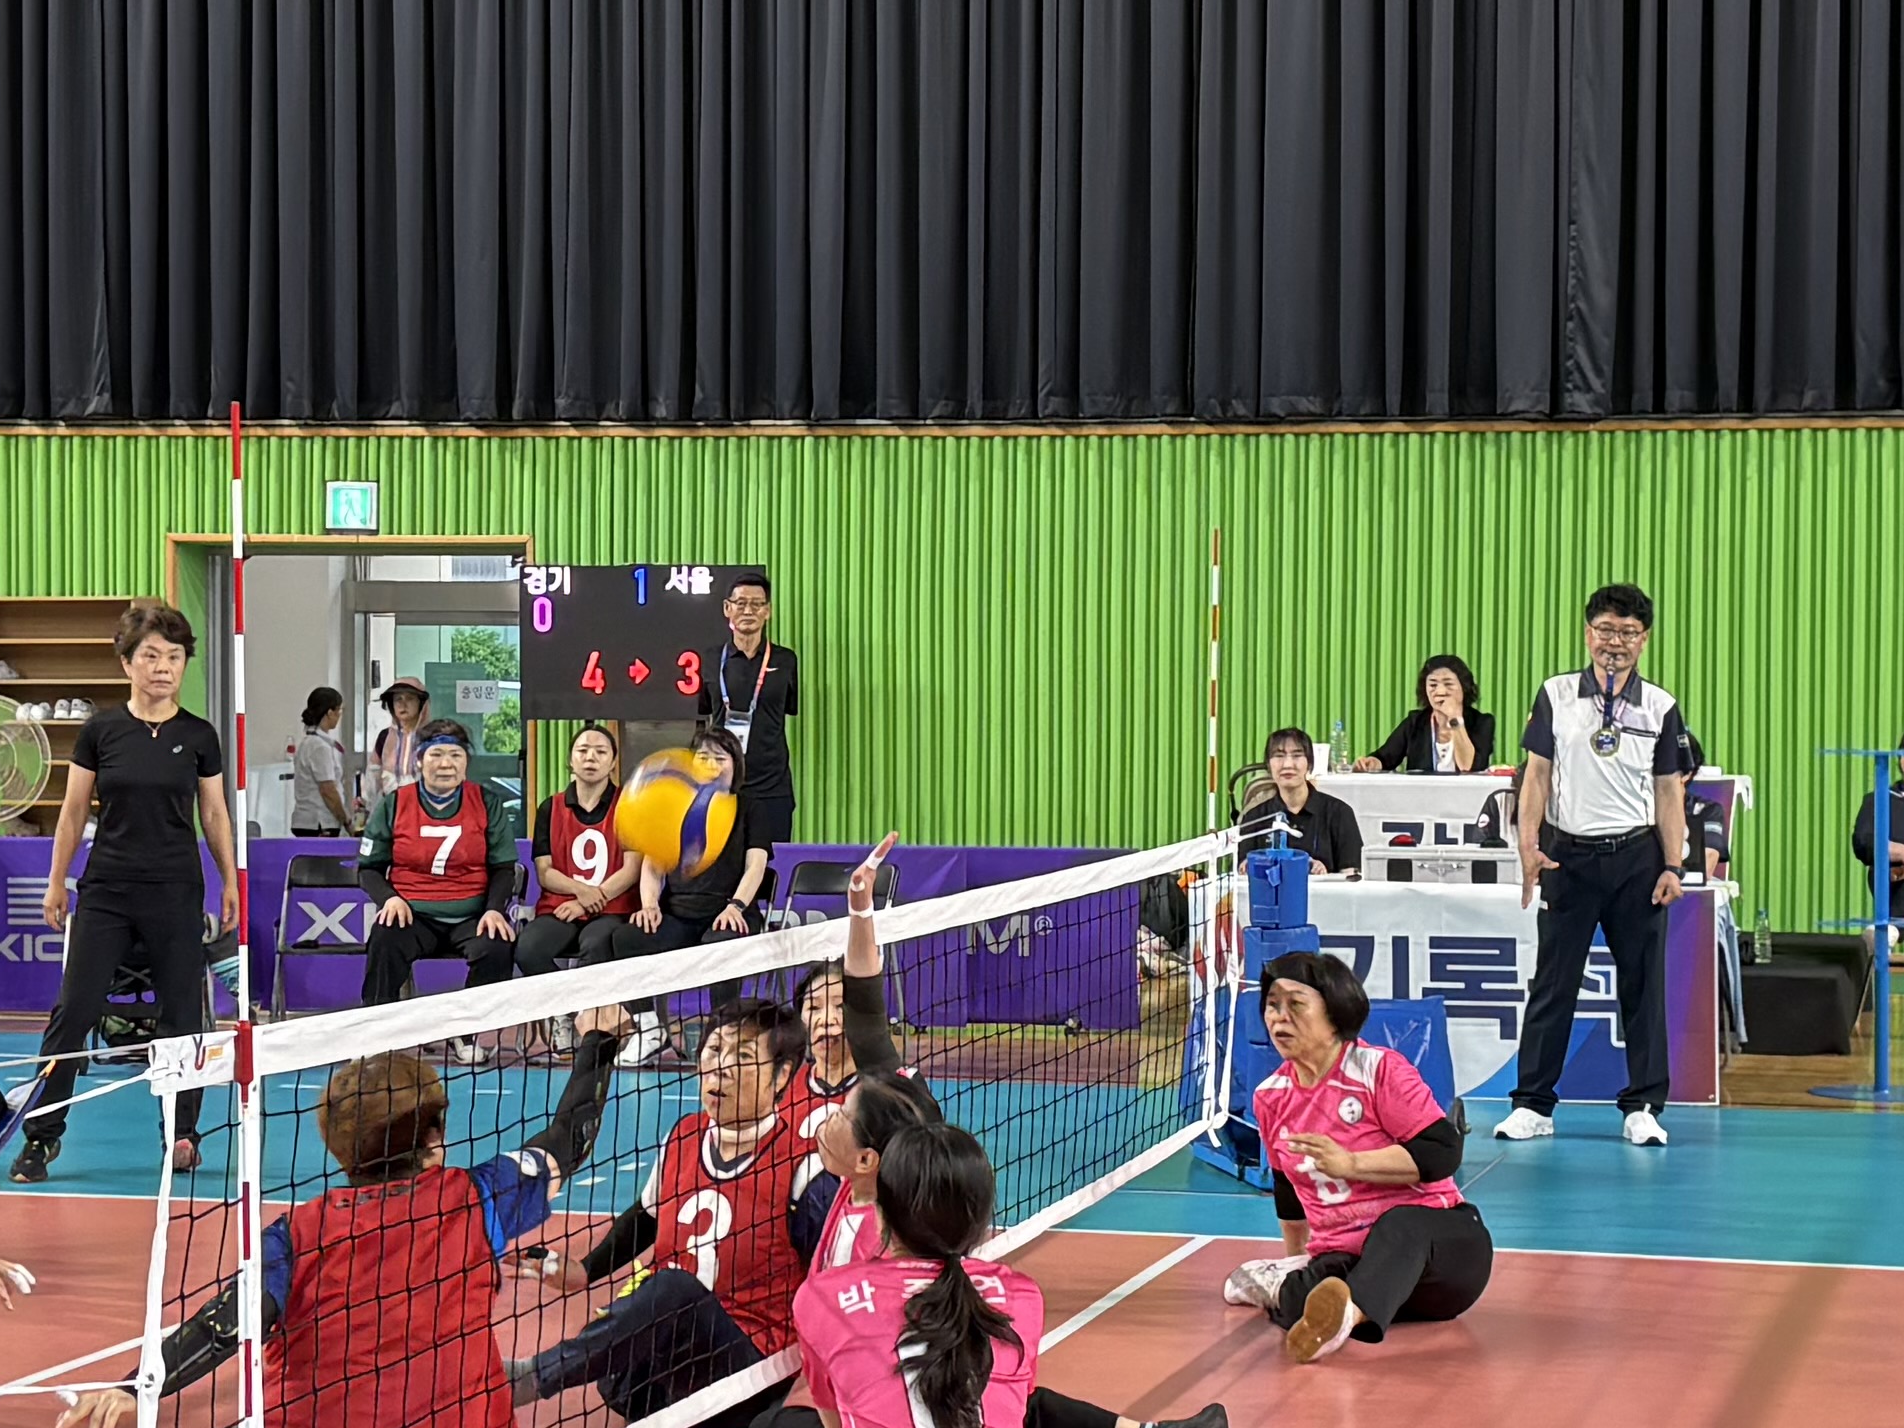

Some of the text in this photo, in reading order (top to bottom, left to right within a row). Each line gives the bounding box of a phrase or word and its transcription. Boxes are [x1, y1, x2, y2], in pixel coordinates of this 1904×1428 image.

[523, 566, 714, 605] 경기 1 서울
[533, 596, 552, 632] 0
[581, 651, 702, 694] 4 3
[461, 685, 495, 700] 출입문
[420, 825, 462, 876] 7
[571, 828, 608, 888] 9
[838, 1280, 875, 1314] 박
